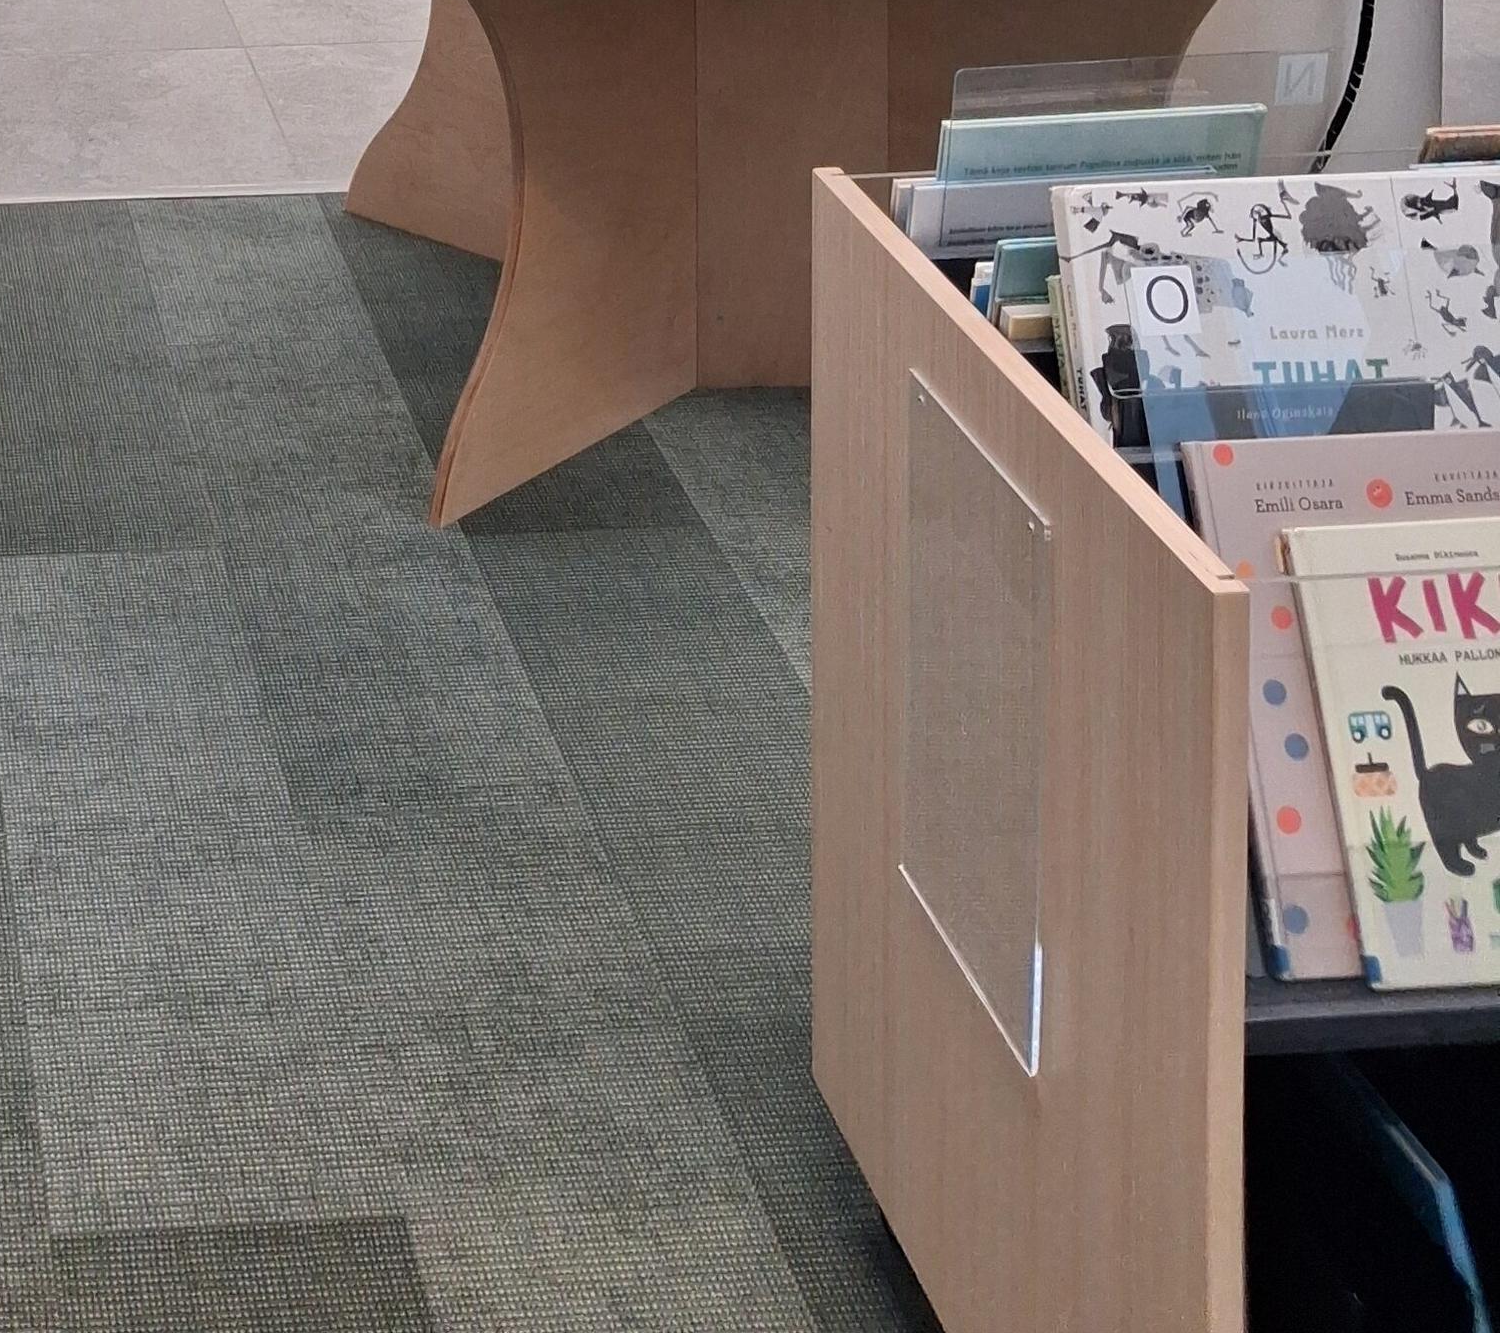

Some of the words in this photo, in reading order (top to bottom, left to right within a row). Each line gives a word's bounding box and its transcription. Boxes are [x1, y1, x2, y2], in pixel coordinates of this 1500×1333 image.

[1270, 326, 1318, 341] Laura
[1326, 325, 1364, 339] Merz
[1255, 498, 1295, 513] Emili
[1299, 497, 1343, 511] Osara
[1405, 490, 1452, 505] Emma
[1367, 571, 1500, 643] KIK
